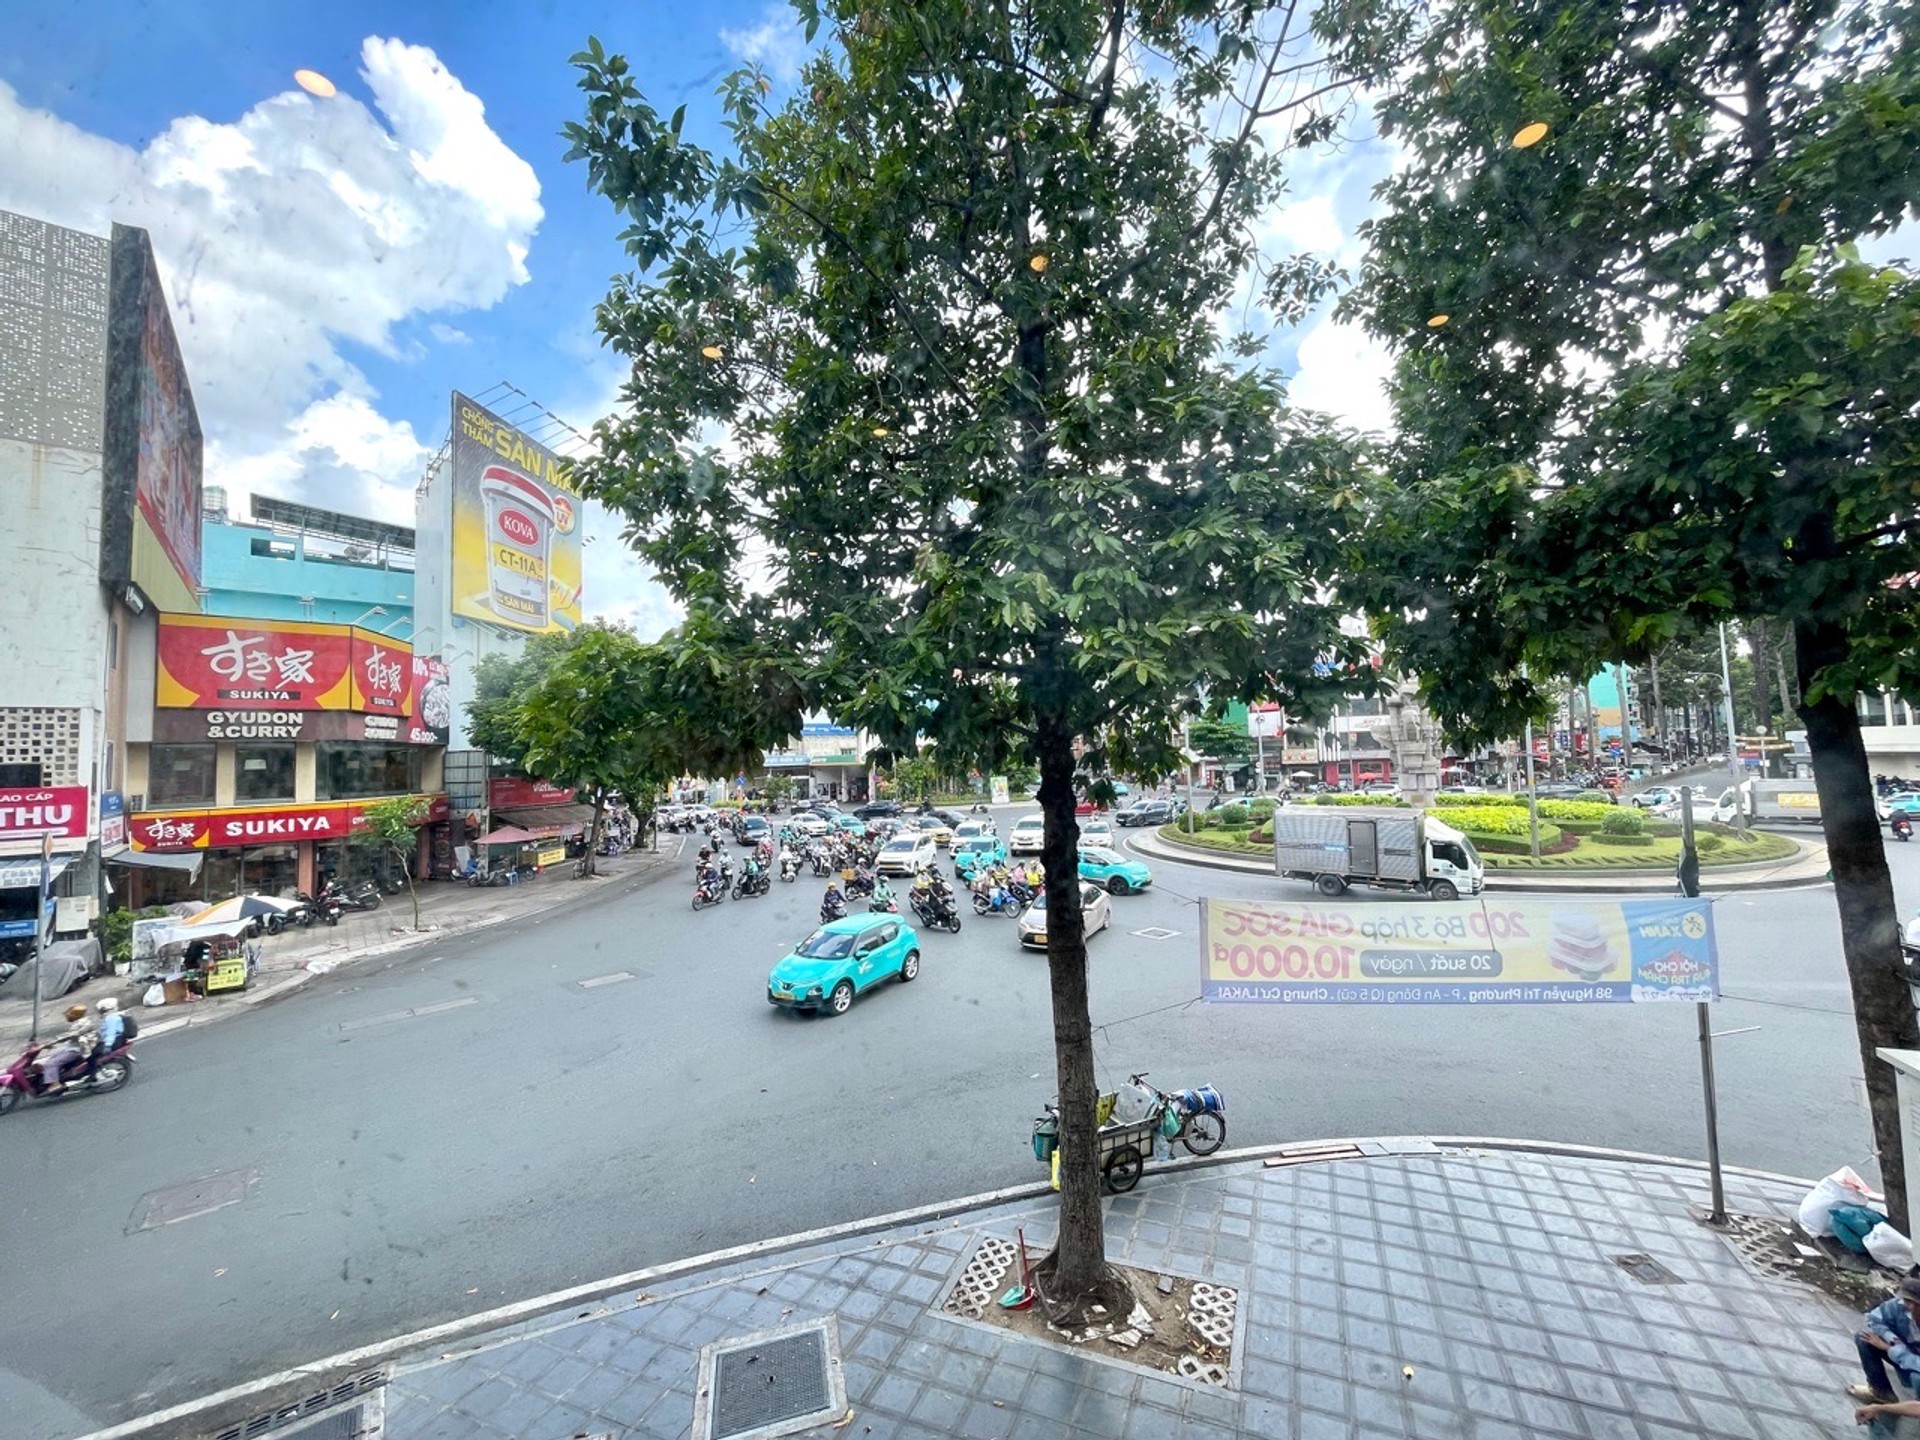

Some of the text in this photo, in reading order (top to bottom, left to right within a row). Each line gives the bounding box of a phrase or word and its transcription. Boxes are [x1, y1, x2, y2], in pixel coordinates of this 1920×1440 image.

[462, 406, 494, 433] CHỐNG
[462, 420, 493, 449] THẤM
[495, 428, 542, 477] SÀN
[503, 515, 534, 541] KOVA
[499, 549, 537, 575] CT-11A
[200, 630, 315, 690] すき家
[364, 645, 403, 697] すき家
[229, 689, 291, 701] SUKIYA
[206, 710, 304, 725] GYUDON
[206, 725, 304, 739] &CURRY
[0, 791, 54, 803] AO CẤP
[0, 803, 73, 828] THU
[225, 816, 331, 837] SUKIYA
[145, 818, 195, 843] すき家
